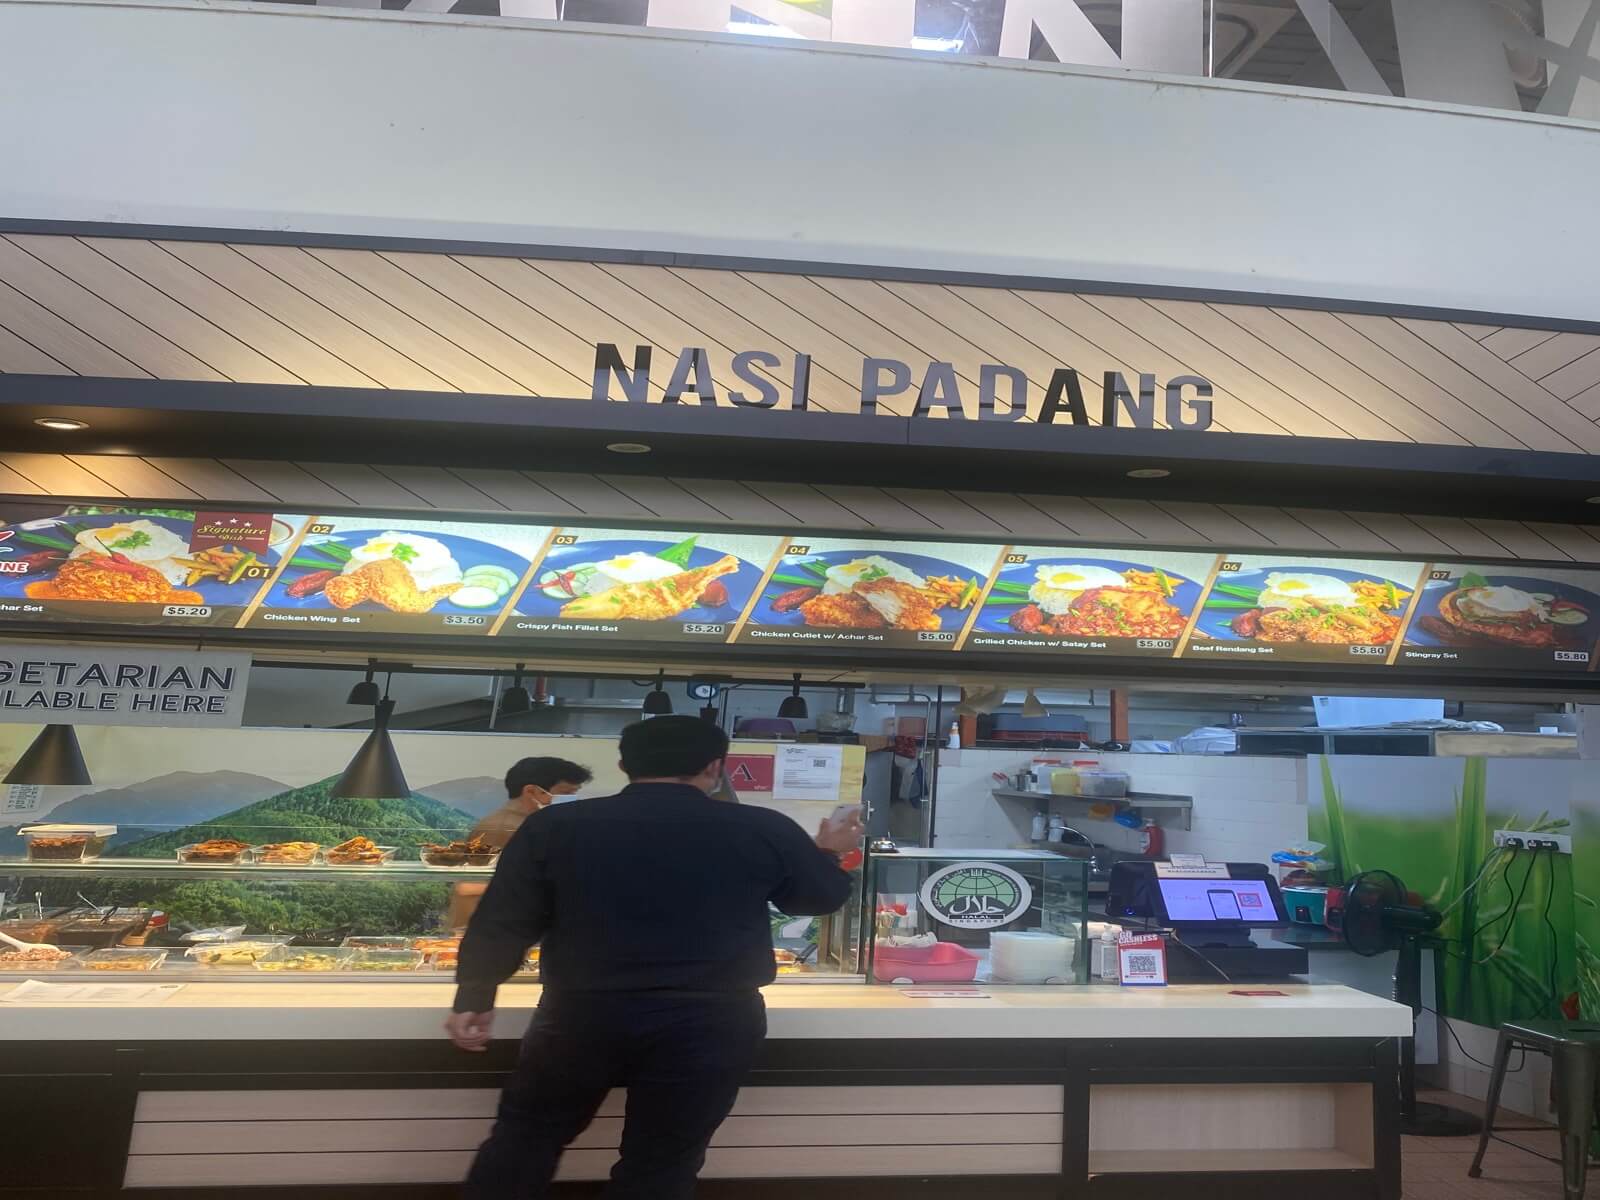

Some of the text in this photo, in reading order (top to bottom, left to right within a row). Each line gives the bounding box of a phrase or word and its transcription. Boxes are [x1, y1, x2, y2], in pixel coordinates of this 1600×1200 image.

[593, 342, 1215, 432] NASI PADANG
[197, 524, 267, 535] Signature
[556, 536, 574, 544] 03
[1007, 555, 1024, 563] 05
[1223, 563, 1239, 571] 06
[248, 567, 270, 577] 01
[167, 607, 208, 616] $5.20
[263, 613, 308, 622] Chicken
[310, 615, 337, 624] Wing
[446, 616, 484, 624] $3.50
[516, 622, 550, 632] Crispy
[551, 624, 573, 632] Fish
[686, 624, 722, 633] $5.20
[750, 630, 791, 638] Chicken
[792, 631, 822, 639] Cutlet
[823, 633, 836, 641] w/
[920, 633, 953, 641] $5.00
[973, 638, 1005, 646] Grilled
[1006, 639, 1046, 647] Chicken
[1061, 641, 1089, 649] Satay
[1139, 639, 1171, 648] $5.00
[1215, 646, 1257, 654] Rendang
[1352, 646, 1384, 655] $5.80
[1405, 651, 1442, 659] Stingray
[1557, 652, 1586, 661] $5.80
[131, 693, 226, 713] HERE
[730, 762, 757, 781] A
